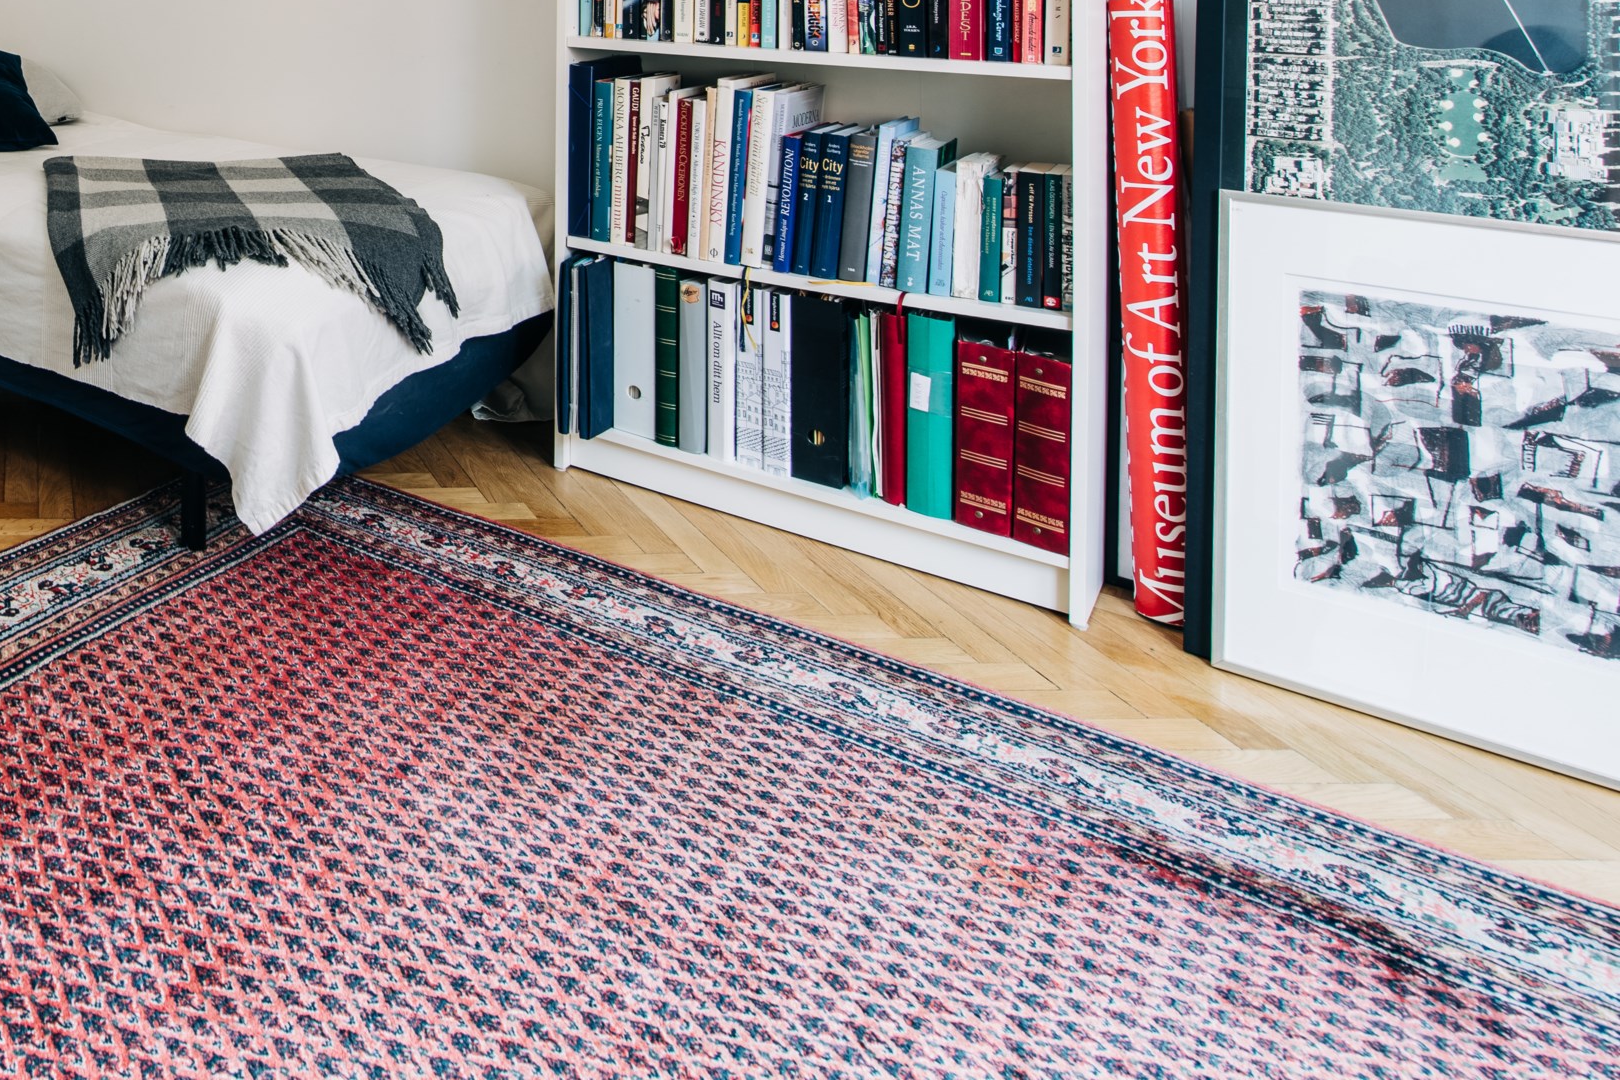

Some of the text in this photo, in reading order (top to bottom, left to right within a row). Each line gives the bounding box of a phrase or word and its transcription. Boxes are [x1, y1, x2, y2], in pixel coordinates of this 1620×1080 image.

[996, 22, 1004, 41] Terror
[615, 86, 625, 130] MONIKA
[614, 134, 624, 183] AHLBERG
[709, 139, 727, 227] KANDINSKY
[780, 148, 794, 216] REVOLUTION!
[800, 157, 819, 173] City
[822, 158, 843, 175] City
[1121, 109, 1174, 230] New
[614, 185, 622, 207] min
[803, 193, 809, 201] 2
[827, 195, 832, 203] 1
[906, 165, 926, 262] ANNAS MAT
[1126, 243, 1180, 338] Art
[713, 321, 722, 403] Allt om ditt hem
[1125, 336, 1183, 398] of
[1139, 405, 1187, 623] Museum
